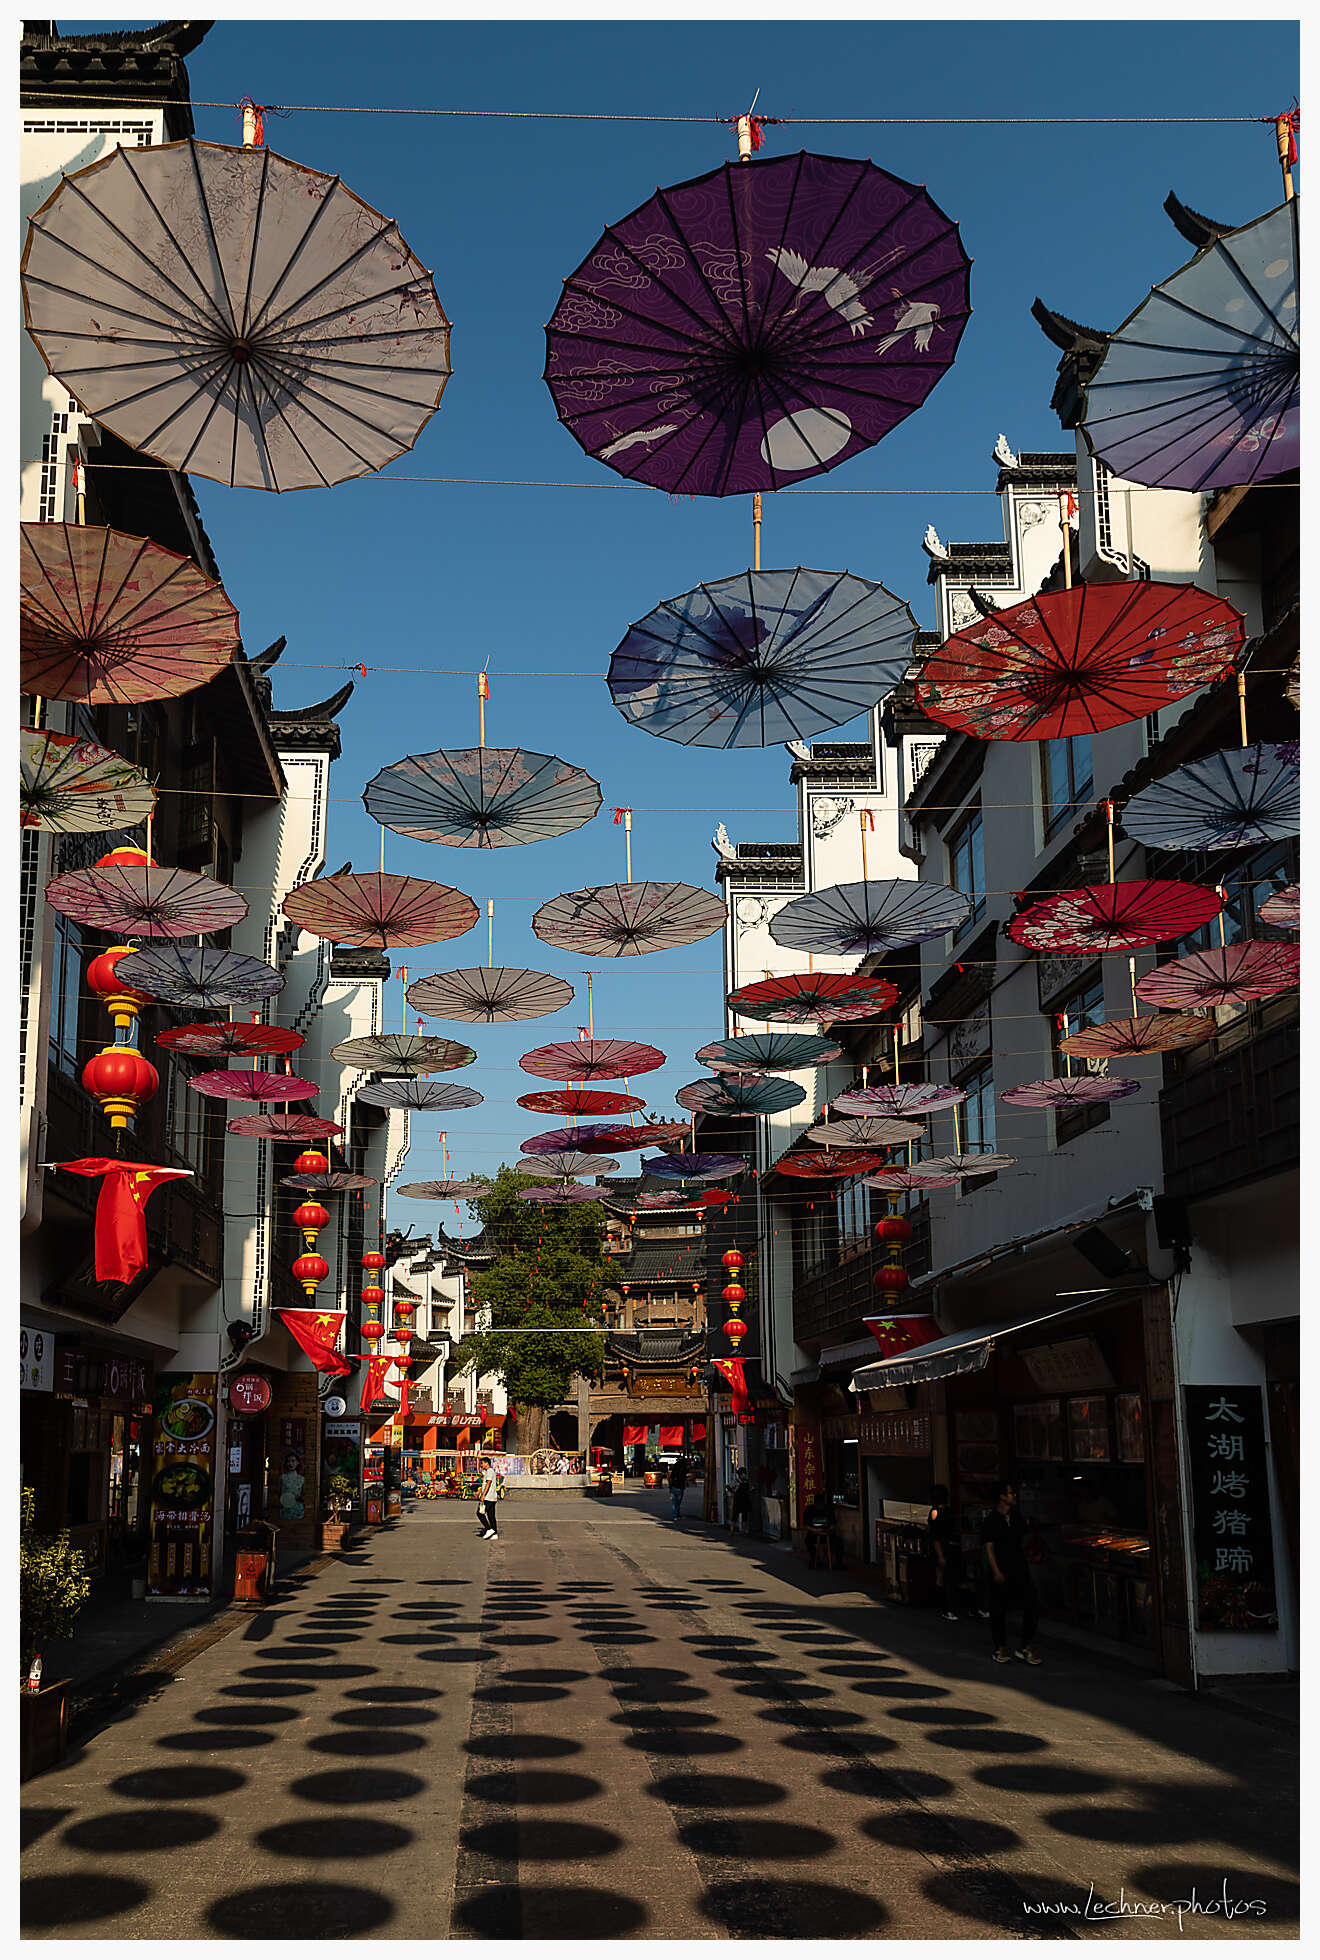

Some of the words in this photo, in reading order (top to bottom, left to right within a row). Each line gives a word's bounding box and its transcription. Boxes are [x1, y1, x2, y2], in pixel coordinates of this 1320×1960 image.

[154, 1510, 211, 1522] 海带排骨汤
[1204, 1396, 1254, 1574] 太湖烤猪蹄
